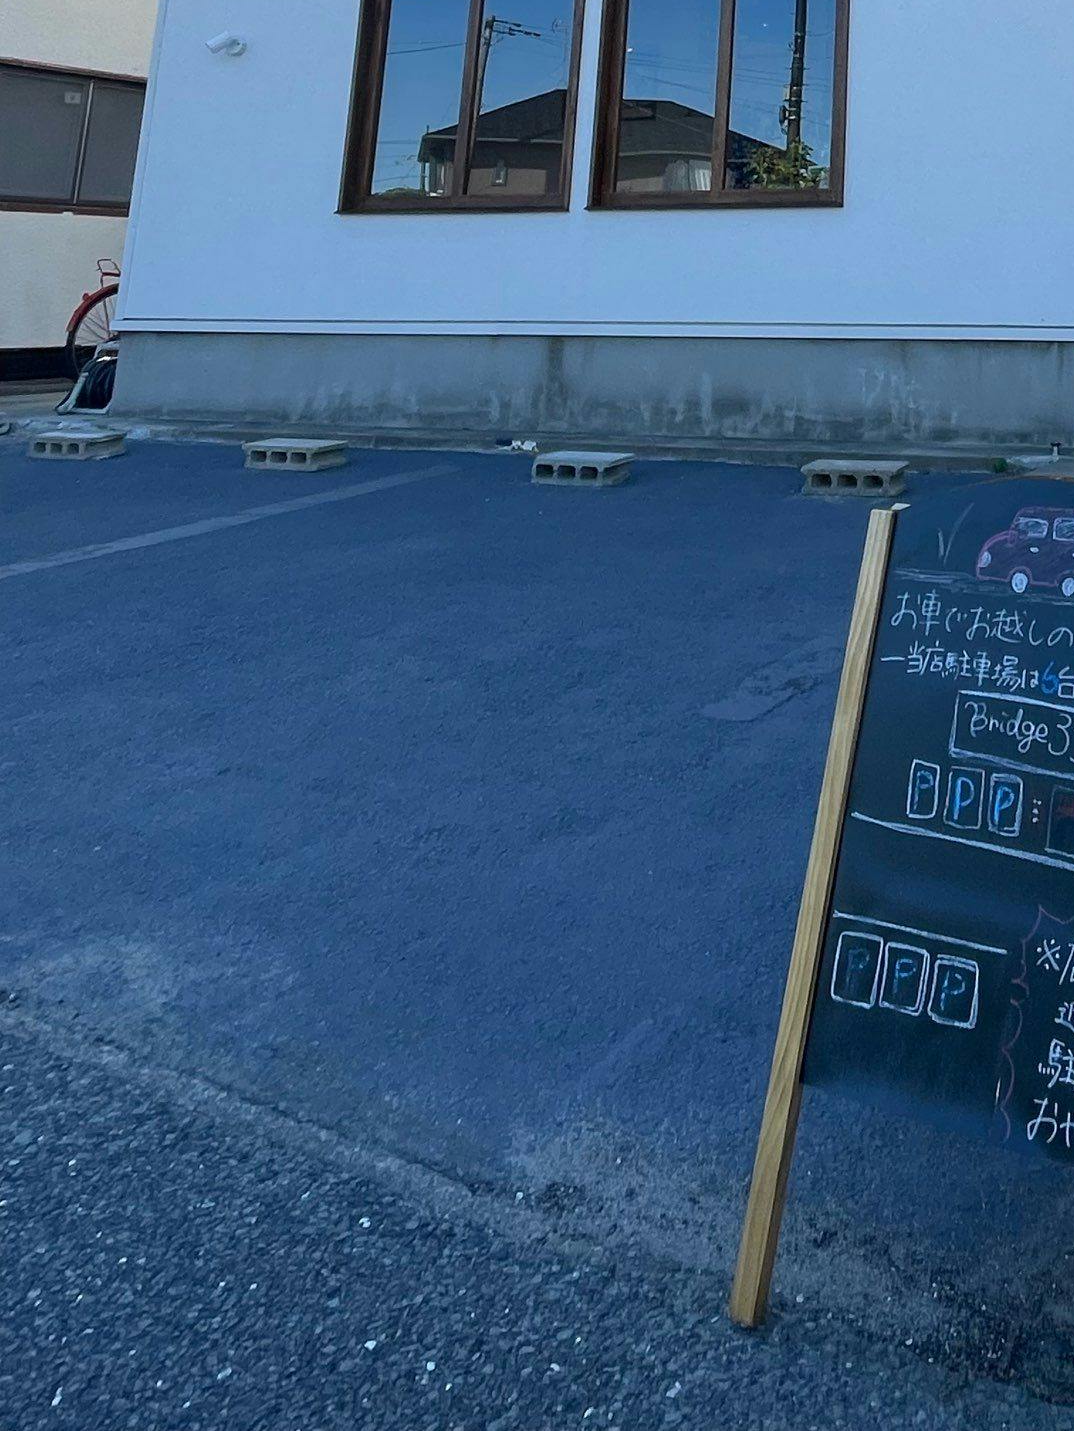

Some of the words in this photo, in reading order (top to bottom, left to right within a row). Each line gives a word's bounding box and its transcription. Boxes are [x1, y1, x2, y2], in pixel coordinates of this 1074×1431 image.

[912, 769, 935, 812] P
[952, 776, 975, 821] P
[993, 785, 1015, 826] P
[893, 958, 917, 995] P
[939, 970, 967, 1012] P
